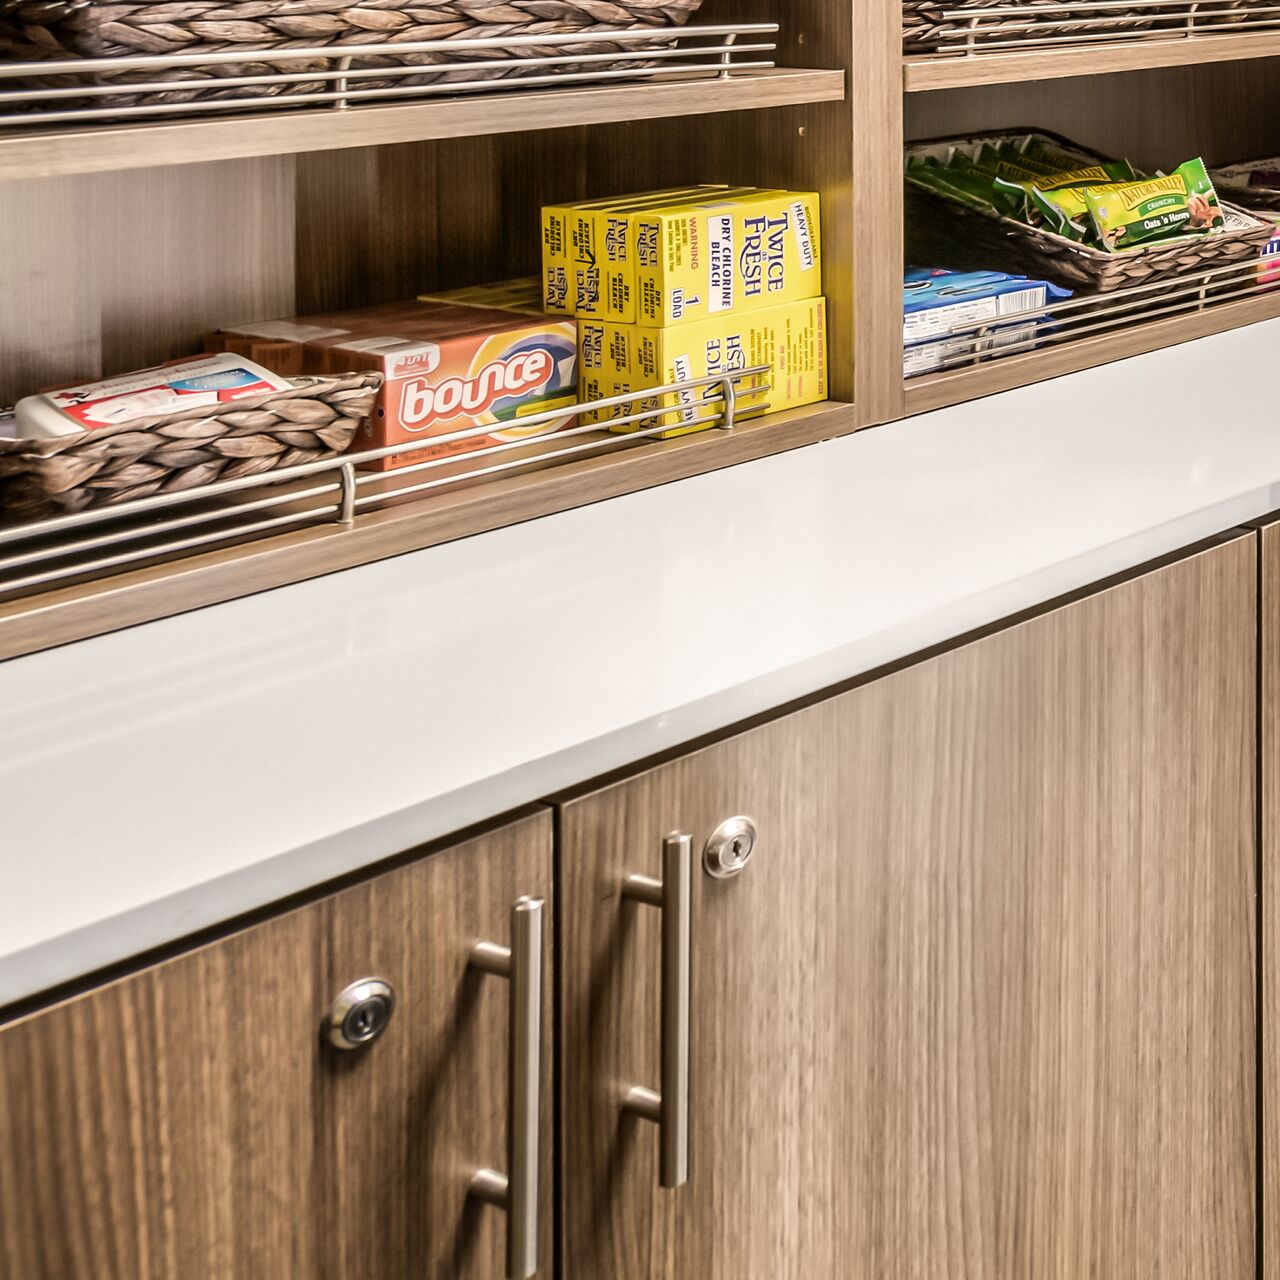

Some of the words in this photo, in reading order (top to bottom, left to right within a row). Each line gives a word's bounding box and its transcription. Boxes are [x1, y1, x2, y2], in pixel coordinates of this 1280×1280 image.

[1123, 184, 1155, 203] NATURE
[1155, 176, 1185, 194] VALLEY
[1147, 198, 1175, 210] CRUNCHY
[689, 217, 699, 270] WARNING
[721, 218, 731, 242] DRY
[795, 205, 807, 239] HEAVY
[802, 241, 812, 266] DUTY
[1144, 219, 1161, 229] Oats
[1169, 212, 1189, 225] Honey
[711, 242, 721, 287] BLEACH
[722, 247, 732, 306] CHLORINE
[740, 216, 766, 296] FRESH
[768, 212, 788, 292] TWICE
[672, 289, 682, 319] LOAD
[403, 352, 547, 424] bounce
